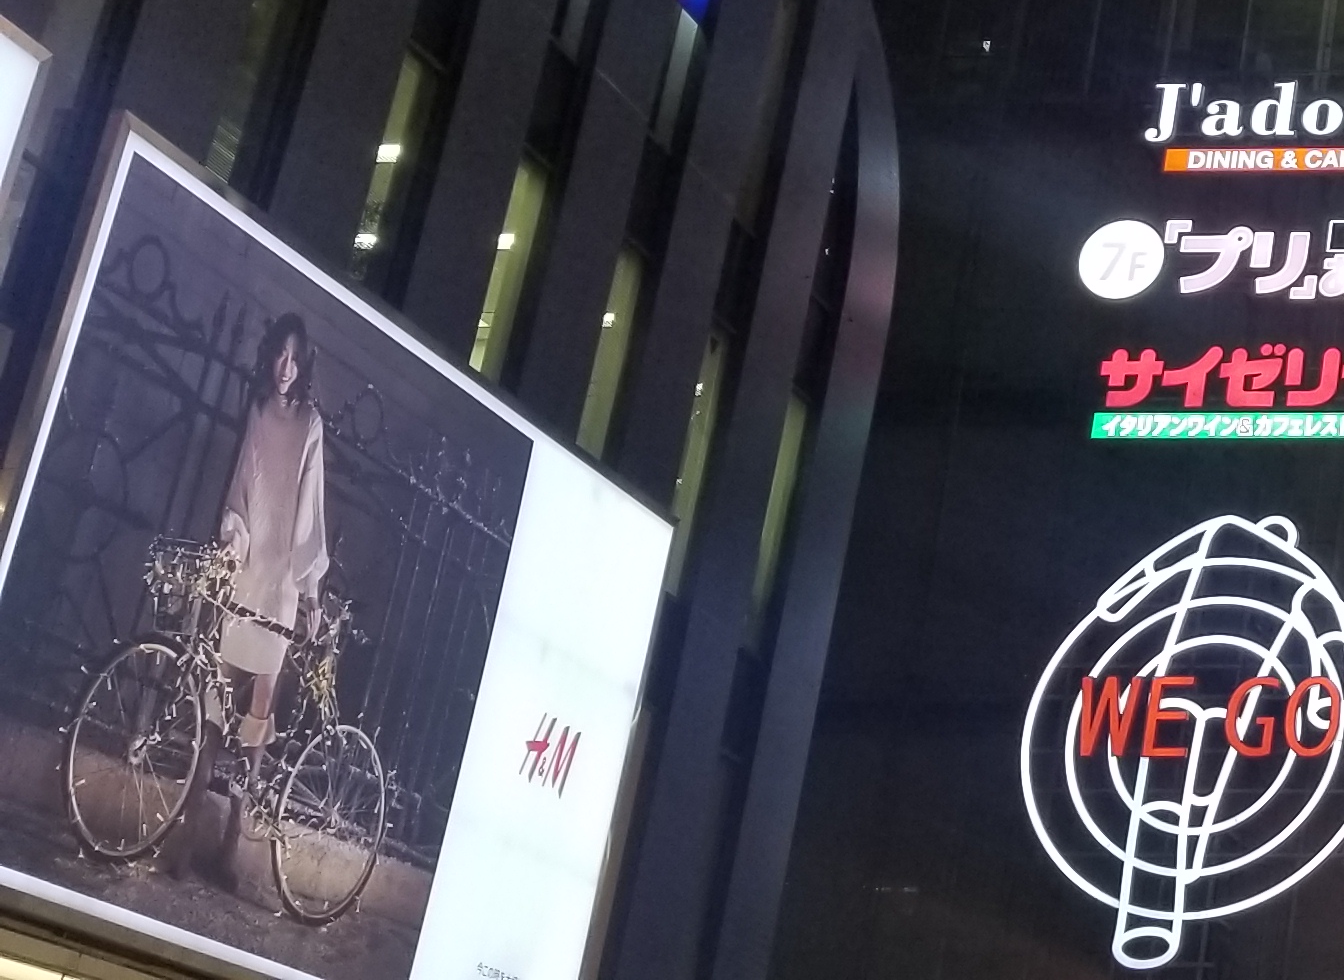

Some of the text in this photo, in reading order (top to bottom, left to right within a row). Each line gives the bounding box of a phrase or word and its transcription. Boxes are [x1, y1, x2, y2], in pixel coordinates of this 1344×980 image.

[1187, 150, 1275, 170] DINING
[1280, 150, 1299, 169] &
[1098, 242, 1148, 282] 7F
[1078, 676, 1341, 758] WE GO
[519, 712, 581, 800] H&M
